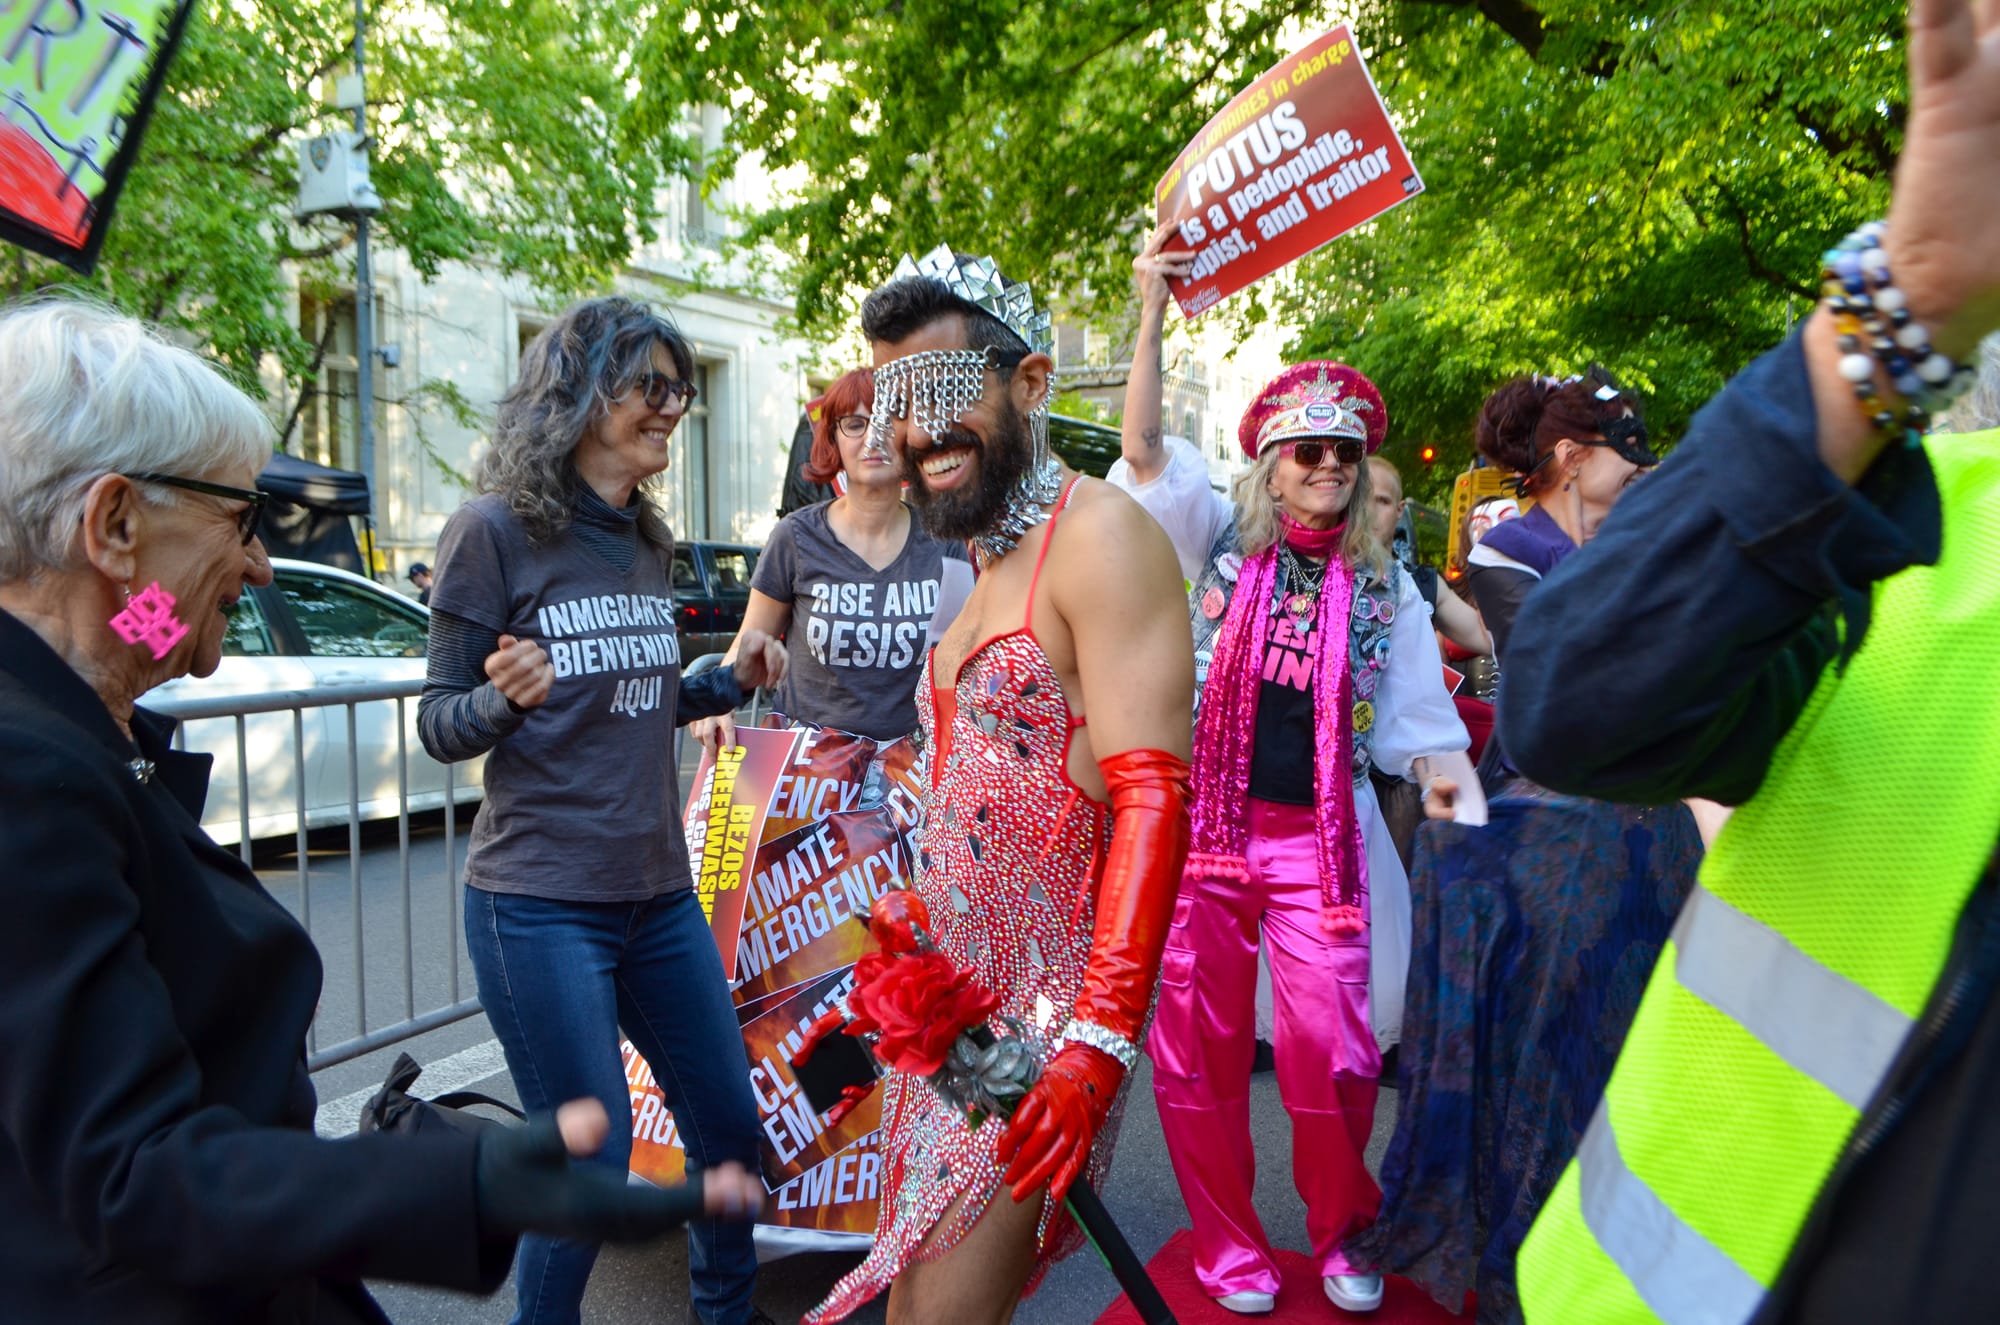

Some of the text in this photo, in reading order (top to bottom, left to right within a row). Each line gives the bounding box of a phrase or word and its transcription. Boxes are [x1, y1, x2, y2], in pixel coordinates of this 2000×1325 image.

[0, 0, 148, 116] RT
[1270, 78, 1290, 101] in
[1291, 39, 1351, 86] charge
[1179, 128, 1363, 248] is a pedophile,
[1187, 100, 1307, 209] POTUS
[1256, 191, 1309, 241] and
[1306, 144, 1392, 211] traitor
[538, 594, 674, 638] INMIGRANTES
[811, 579, 940, 617] RISE AND
[610, 676, 662, 717] AQUI
[1262, 645, 1314, 692] IN
[688, 820, 707, 894] CLIM
[719, 804, 757, 891] BEZOS
[729, 842, 901, 993] MERGENCY
